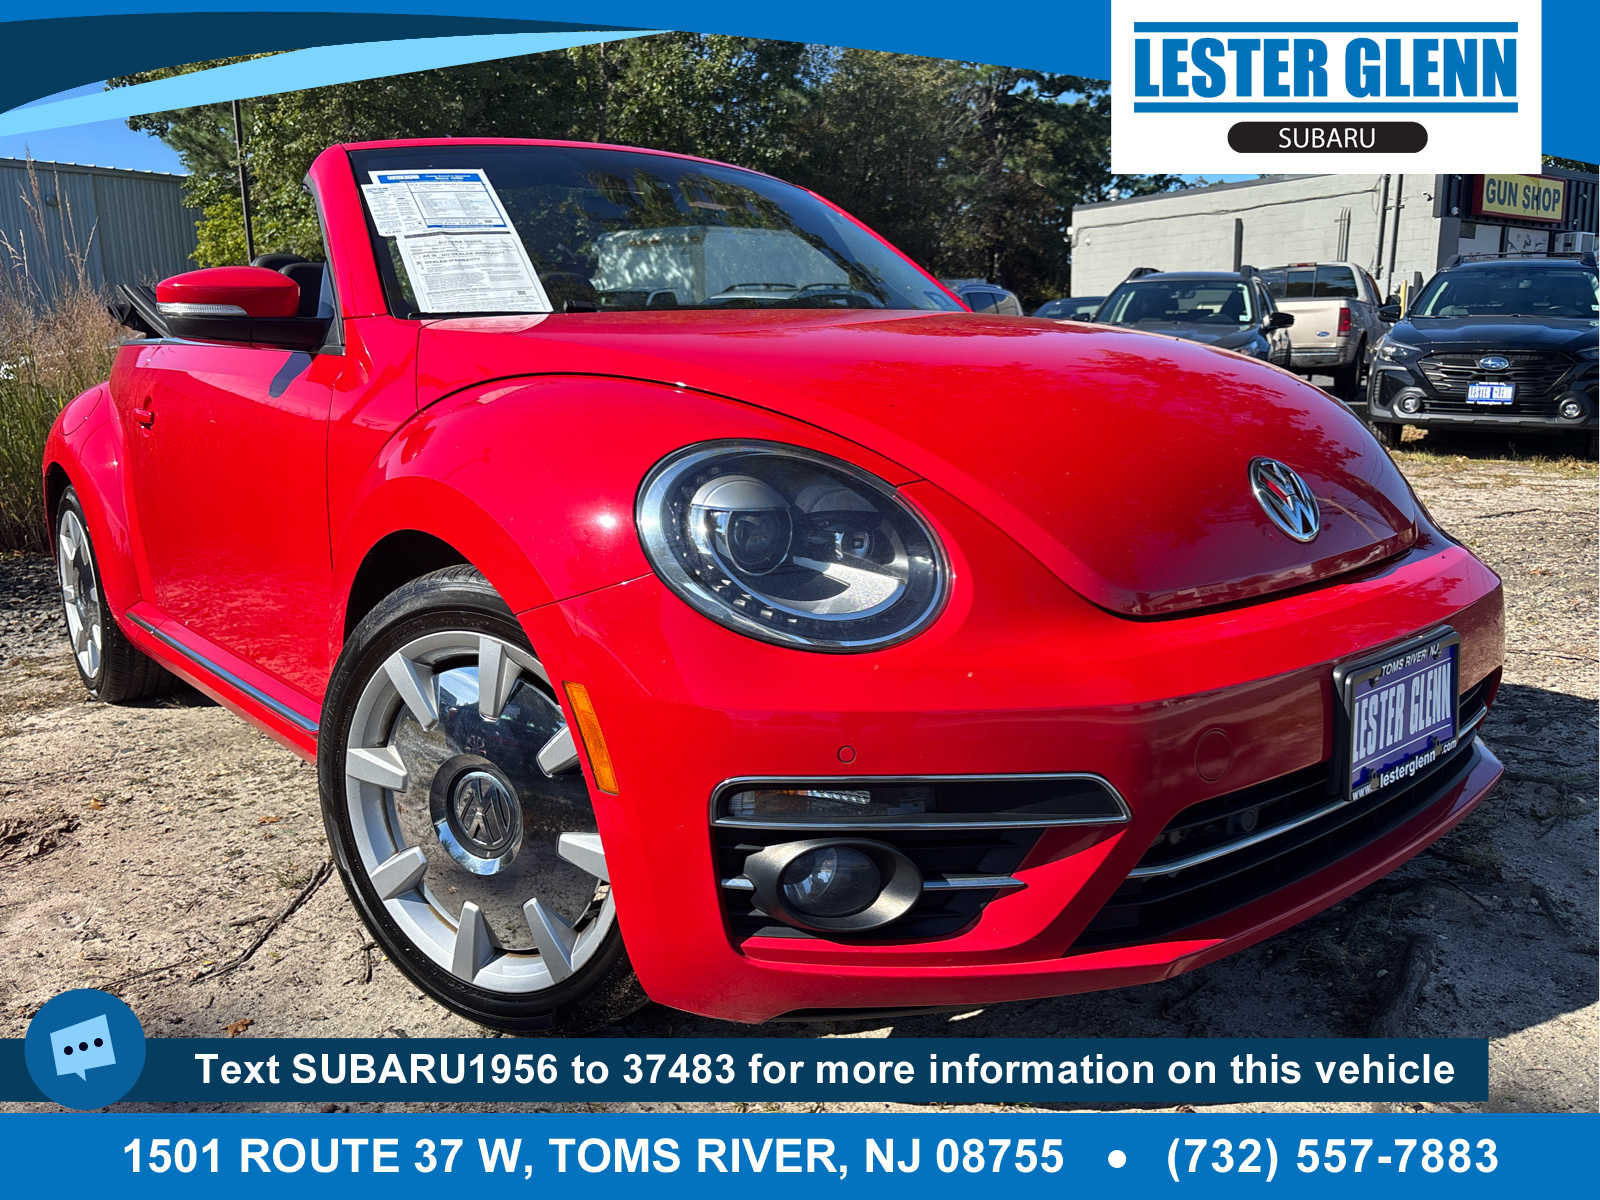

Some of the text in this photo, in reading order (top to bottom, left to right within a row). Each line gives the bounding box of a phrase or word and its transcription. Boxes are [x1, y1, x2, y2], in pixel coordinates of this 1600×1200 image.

[1486, 178, 1560, 212] GUN SHOP
[1381, 658, 1404, 676] TOMS
[1405, 648, 1426, 668] RIVER
[1352, 662, 1451, 765] LESTER GLENN
